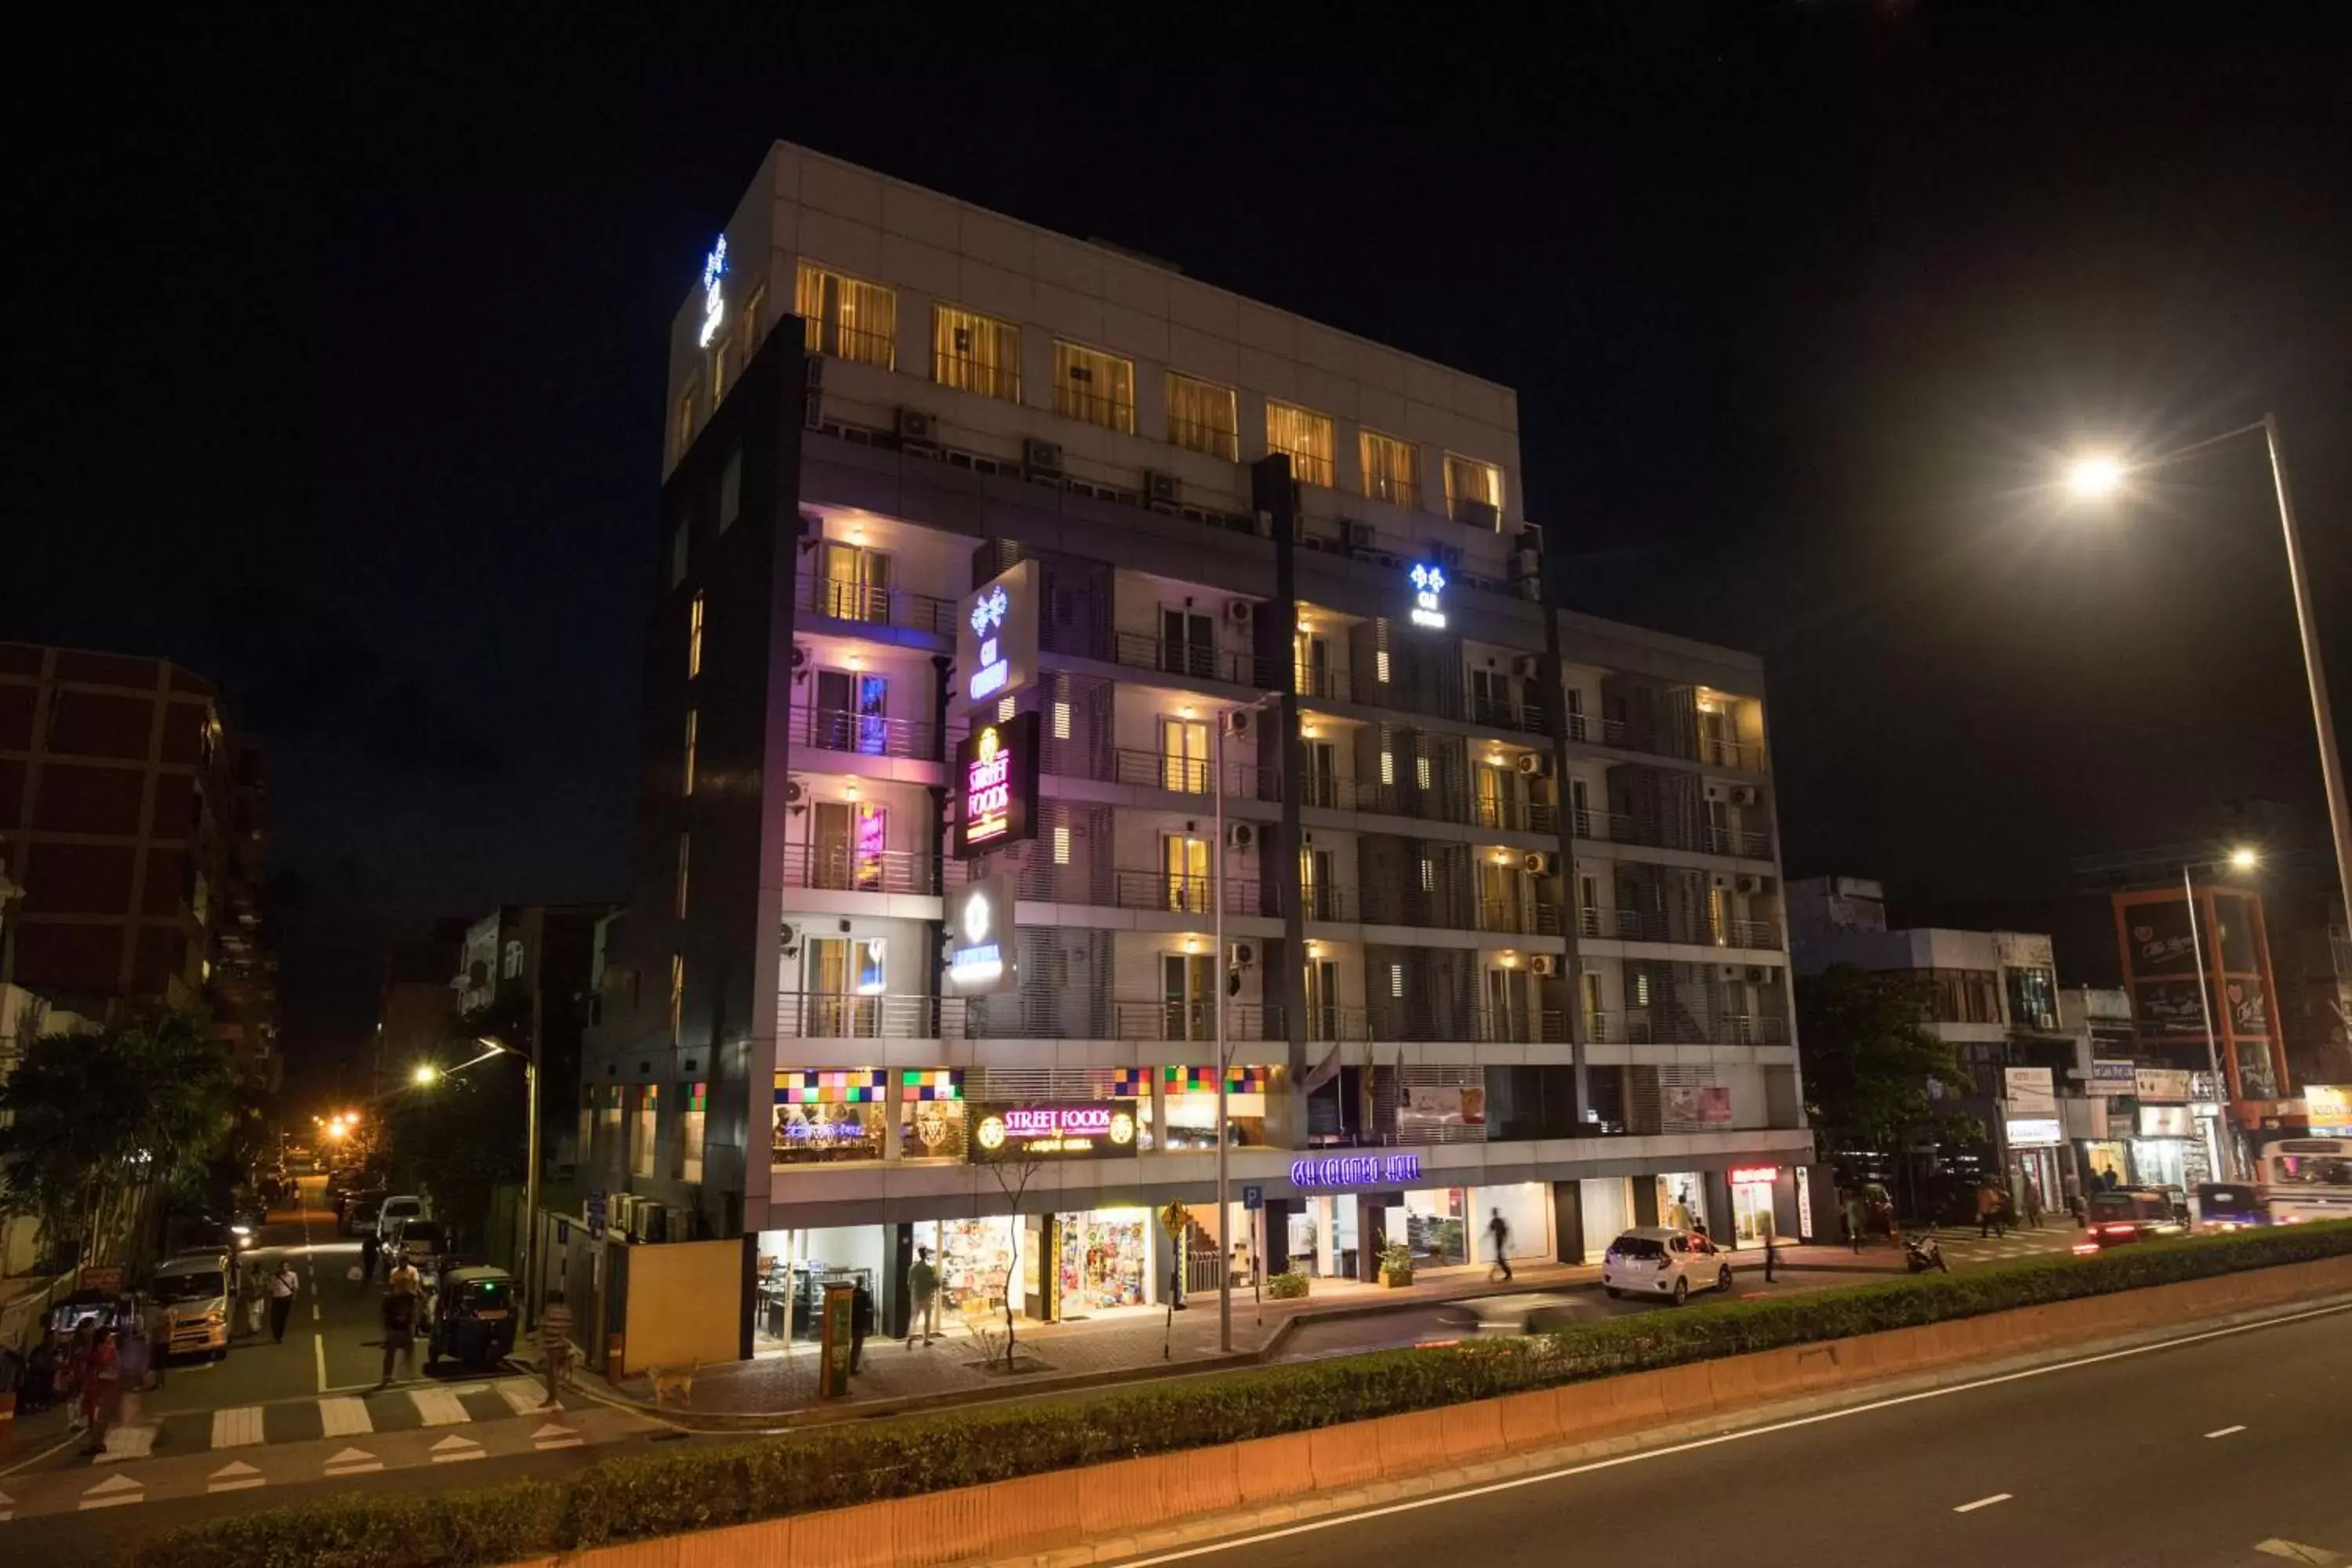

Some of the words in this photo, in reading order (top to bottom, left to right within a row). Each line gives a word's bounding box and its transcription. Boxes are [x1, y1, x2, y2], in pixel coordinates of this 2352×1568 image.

[968, 783, 1009, 817] FOODS
[1005, 1111, 1058, 1129] STREET
[1062, 1109, 1109, 1127] FOODS
[1319, 1156, 1379, 1185] COLOMBO
[1385, 1154, 1421, 1181] HOTEL
[1247, 1189, 1258, 1206] P
